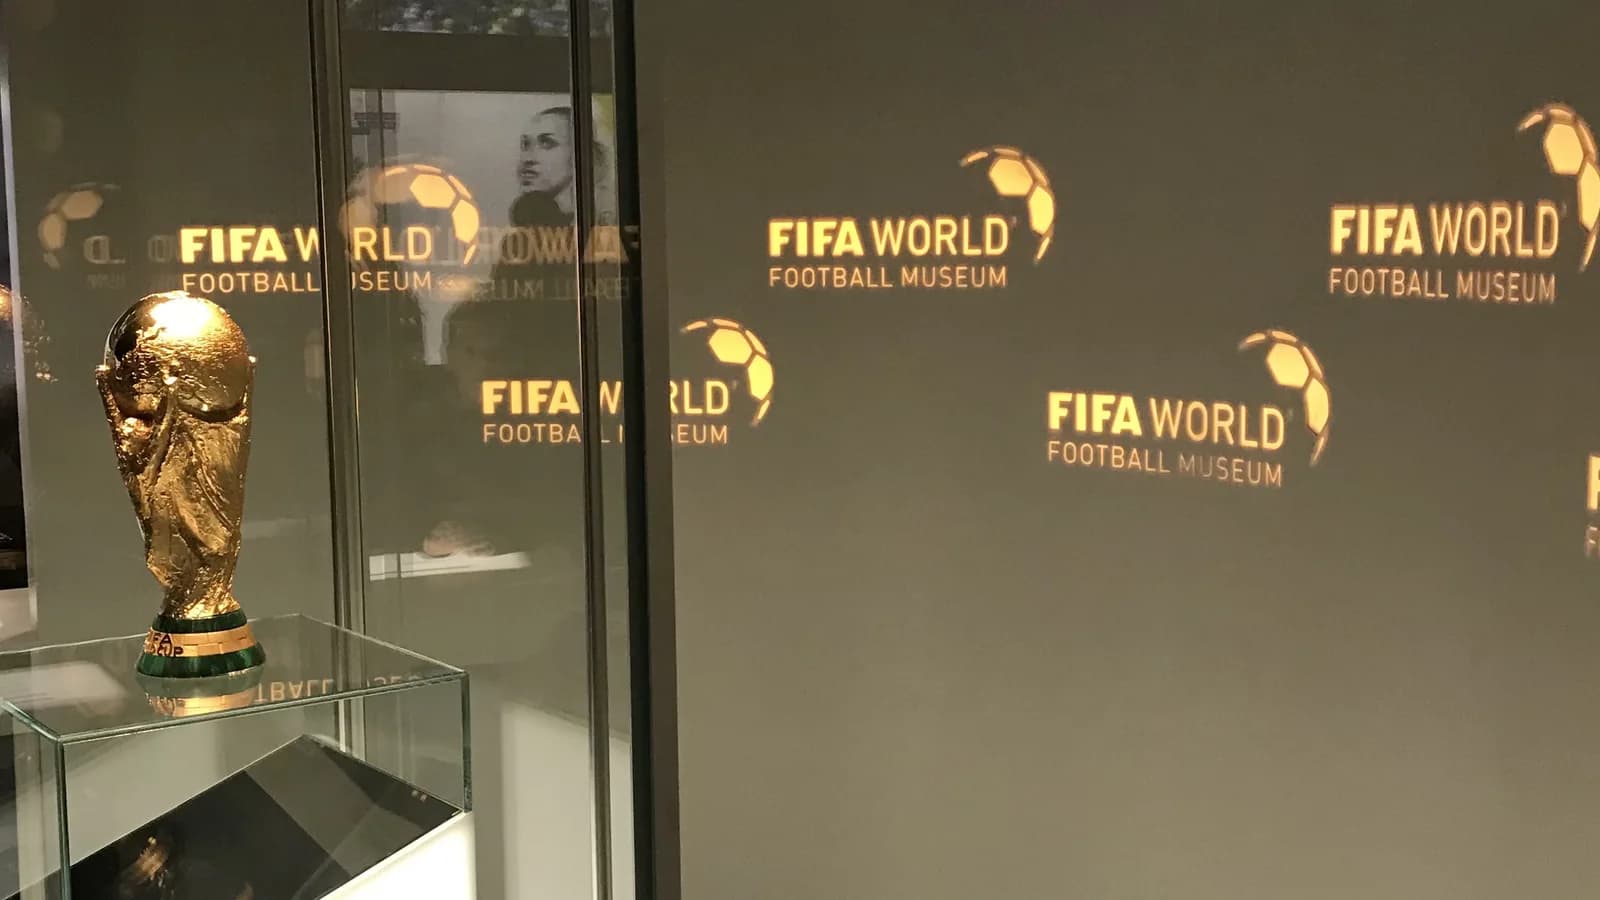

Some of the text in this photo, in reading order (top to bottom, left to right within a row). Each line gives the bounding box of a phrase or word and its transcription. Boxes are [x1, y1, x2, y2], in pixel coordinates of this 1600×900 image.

[180, 228, 287, 263] FIFA
[294, 227, 432, 262] WRLD
[768, 217, 1009, 257] FIFA WORLD
[1330, 205, 1560, 257] FIFA WORLD
[182, 271, 320, 293] FOOTBALL
[351, 270, 432, 292] SEUM
[769, 266, 1007, 289] FOOTBALL MUSEUM
[1329, 268, 1557, 303] FOOTBALL MUSEUM
[482, 380, 580, 415] FIFA
[1048, 391, 1285, 450] FIFA WORLD
[1048, 440, 1283, 488] FOOTBALL MUSEUM
